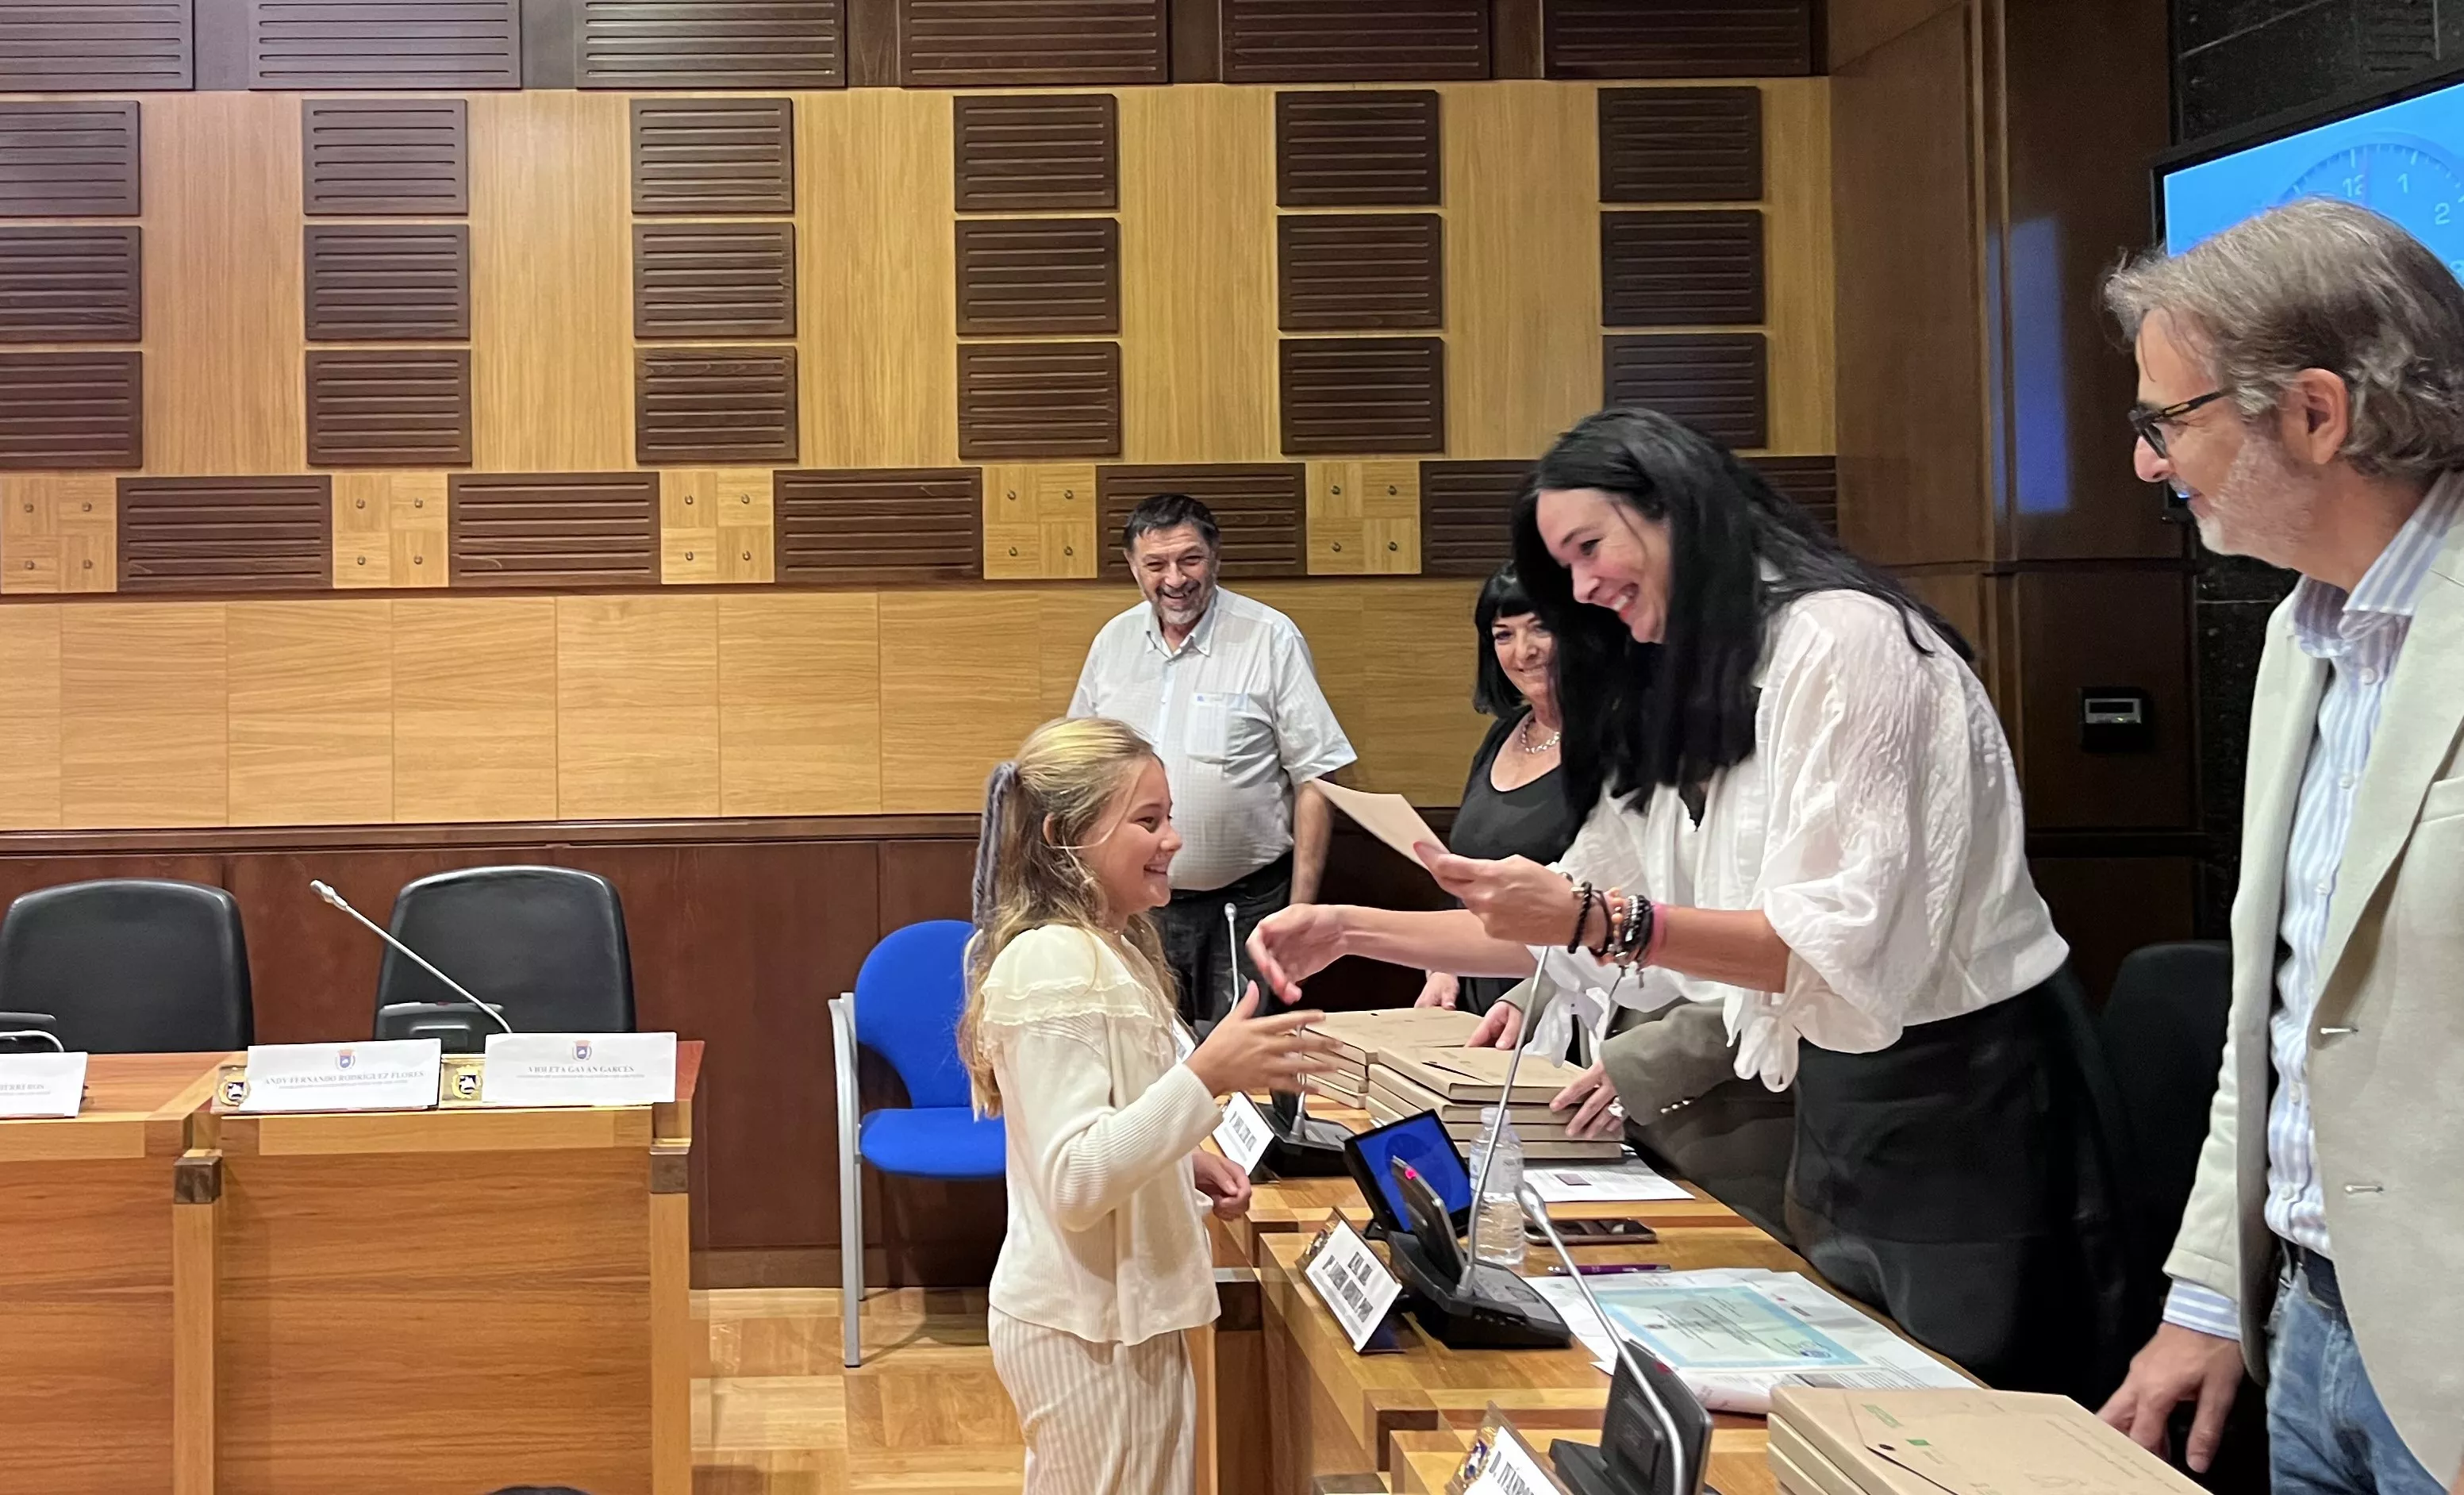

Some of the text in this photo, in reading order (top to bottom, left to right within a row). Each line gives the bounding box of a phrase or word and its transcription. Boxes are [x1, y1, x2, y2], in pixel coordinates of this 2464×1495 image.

[2342, 173, 2365, 198] 12
[2397, 172, 2409, 194] 1
[2434, 202, 2451, 226] 2
[290, 1075, 337, 1085] FERNANDO
